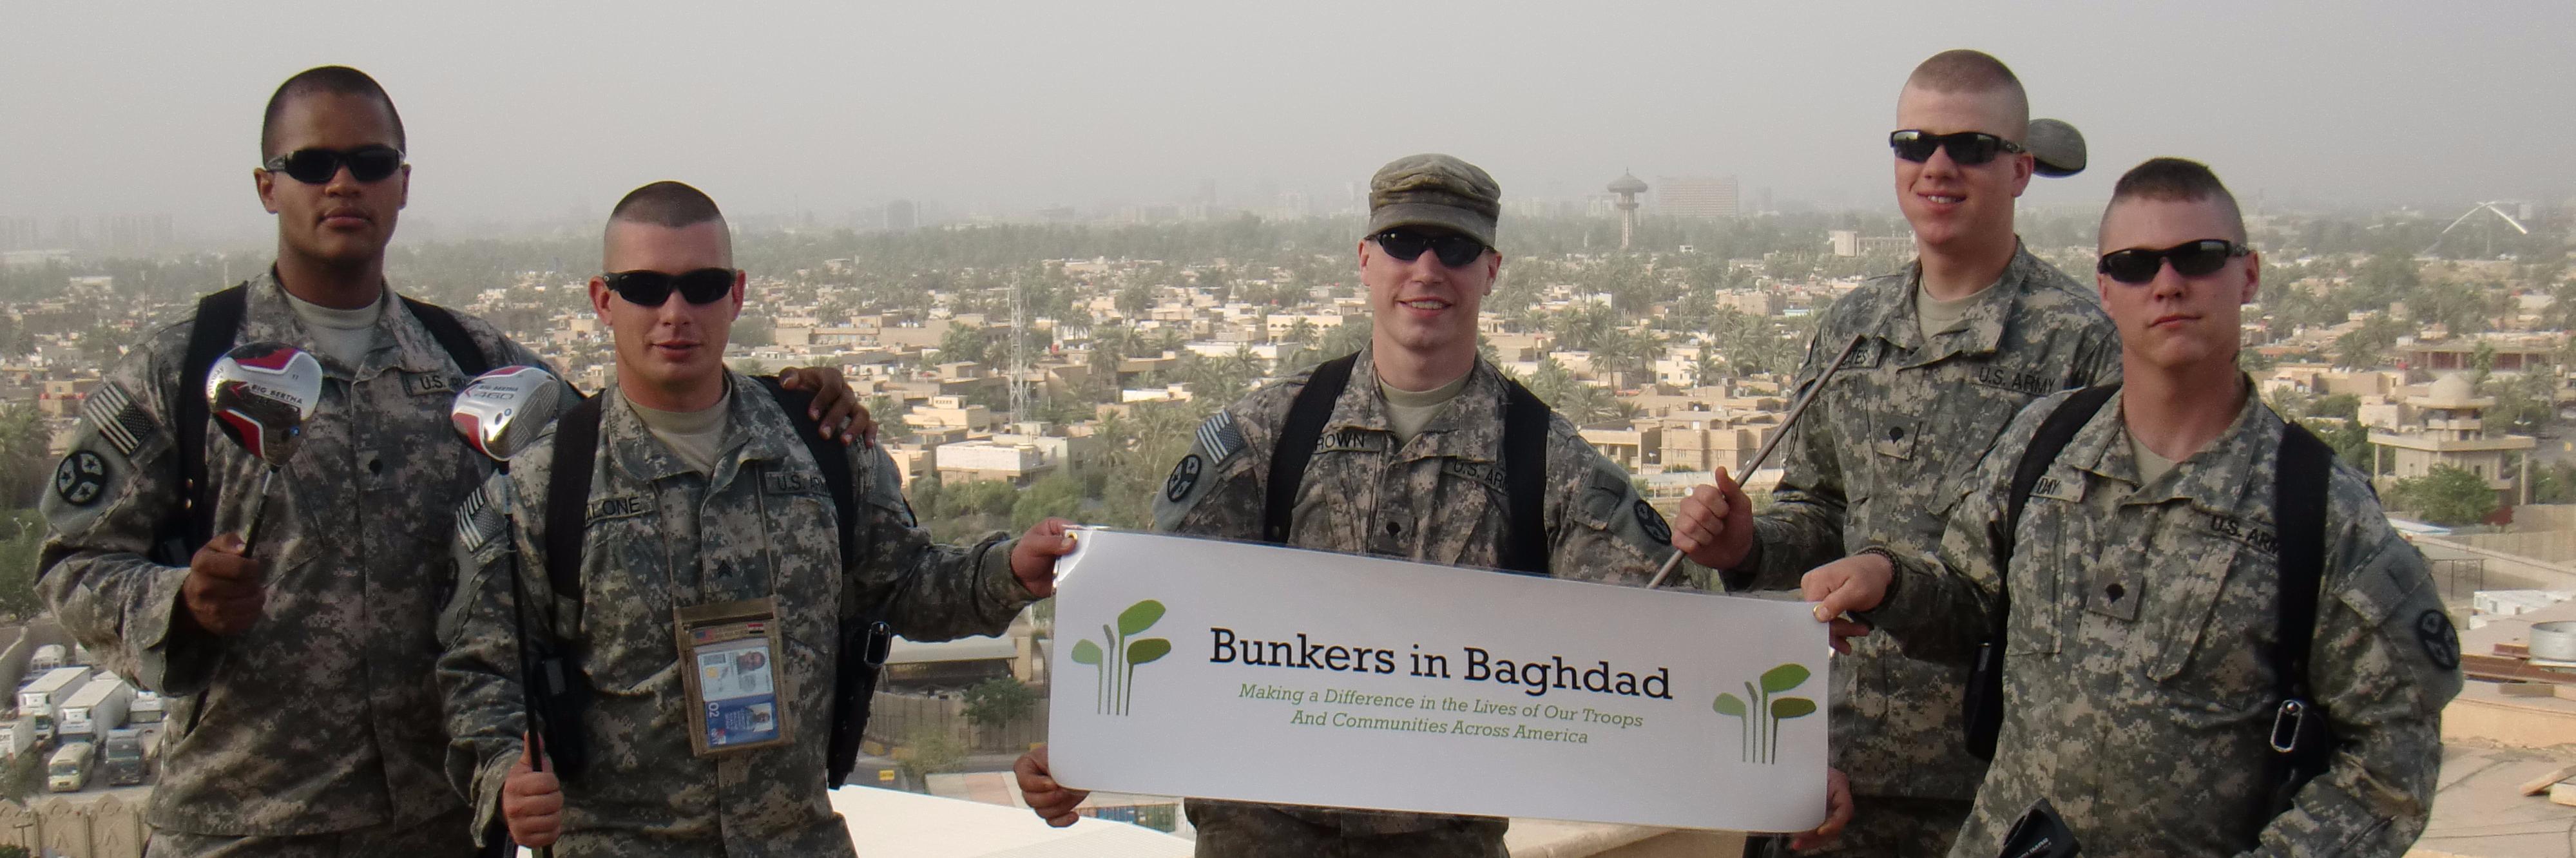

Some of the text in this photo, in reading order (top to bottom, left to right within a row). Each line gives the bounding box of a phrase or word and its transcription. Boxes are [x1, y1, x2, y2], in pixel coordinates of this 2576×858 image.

[419, 376, 446, 390] U.S.
[1979, 367, 2055, 394] U.S. ARMY
[252, 384, 266, 394] BIG
[269, 390, 303, 405] BERTHA
[1315, 432, 1365, 451] ROWN
[777, 475, 805, 490] U.S.
[1454, 461, 1506, 490] U.S. AR
[2037, 477, 2061, 495] DAY
[585, 497, 640, 520] ALONE
[1209, 627, 1673, 700] Bunkers in Baghdad
[1239, 683, 1643, 729] Making a Difference in the Lives of Our Troops
[1291, 710, 1588, 743] And Communities Across America
